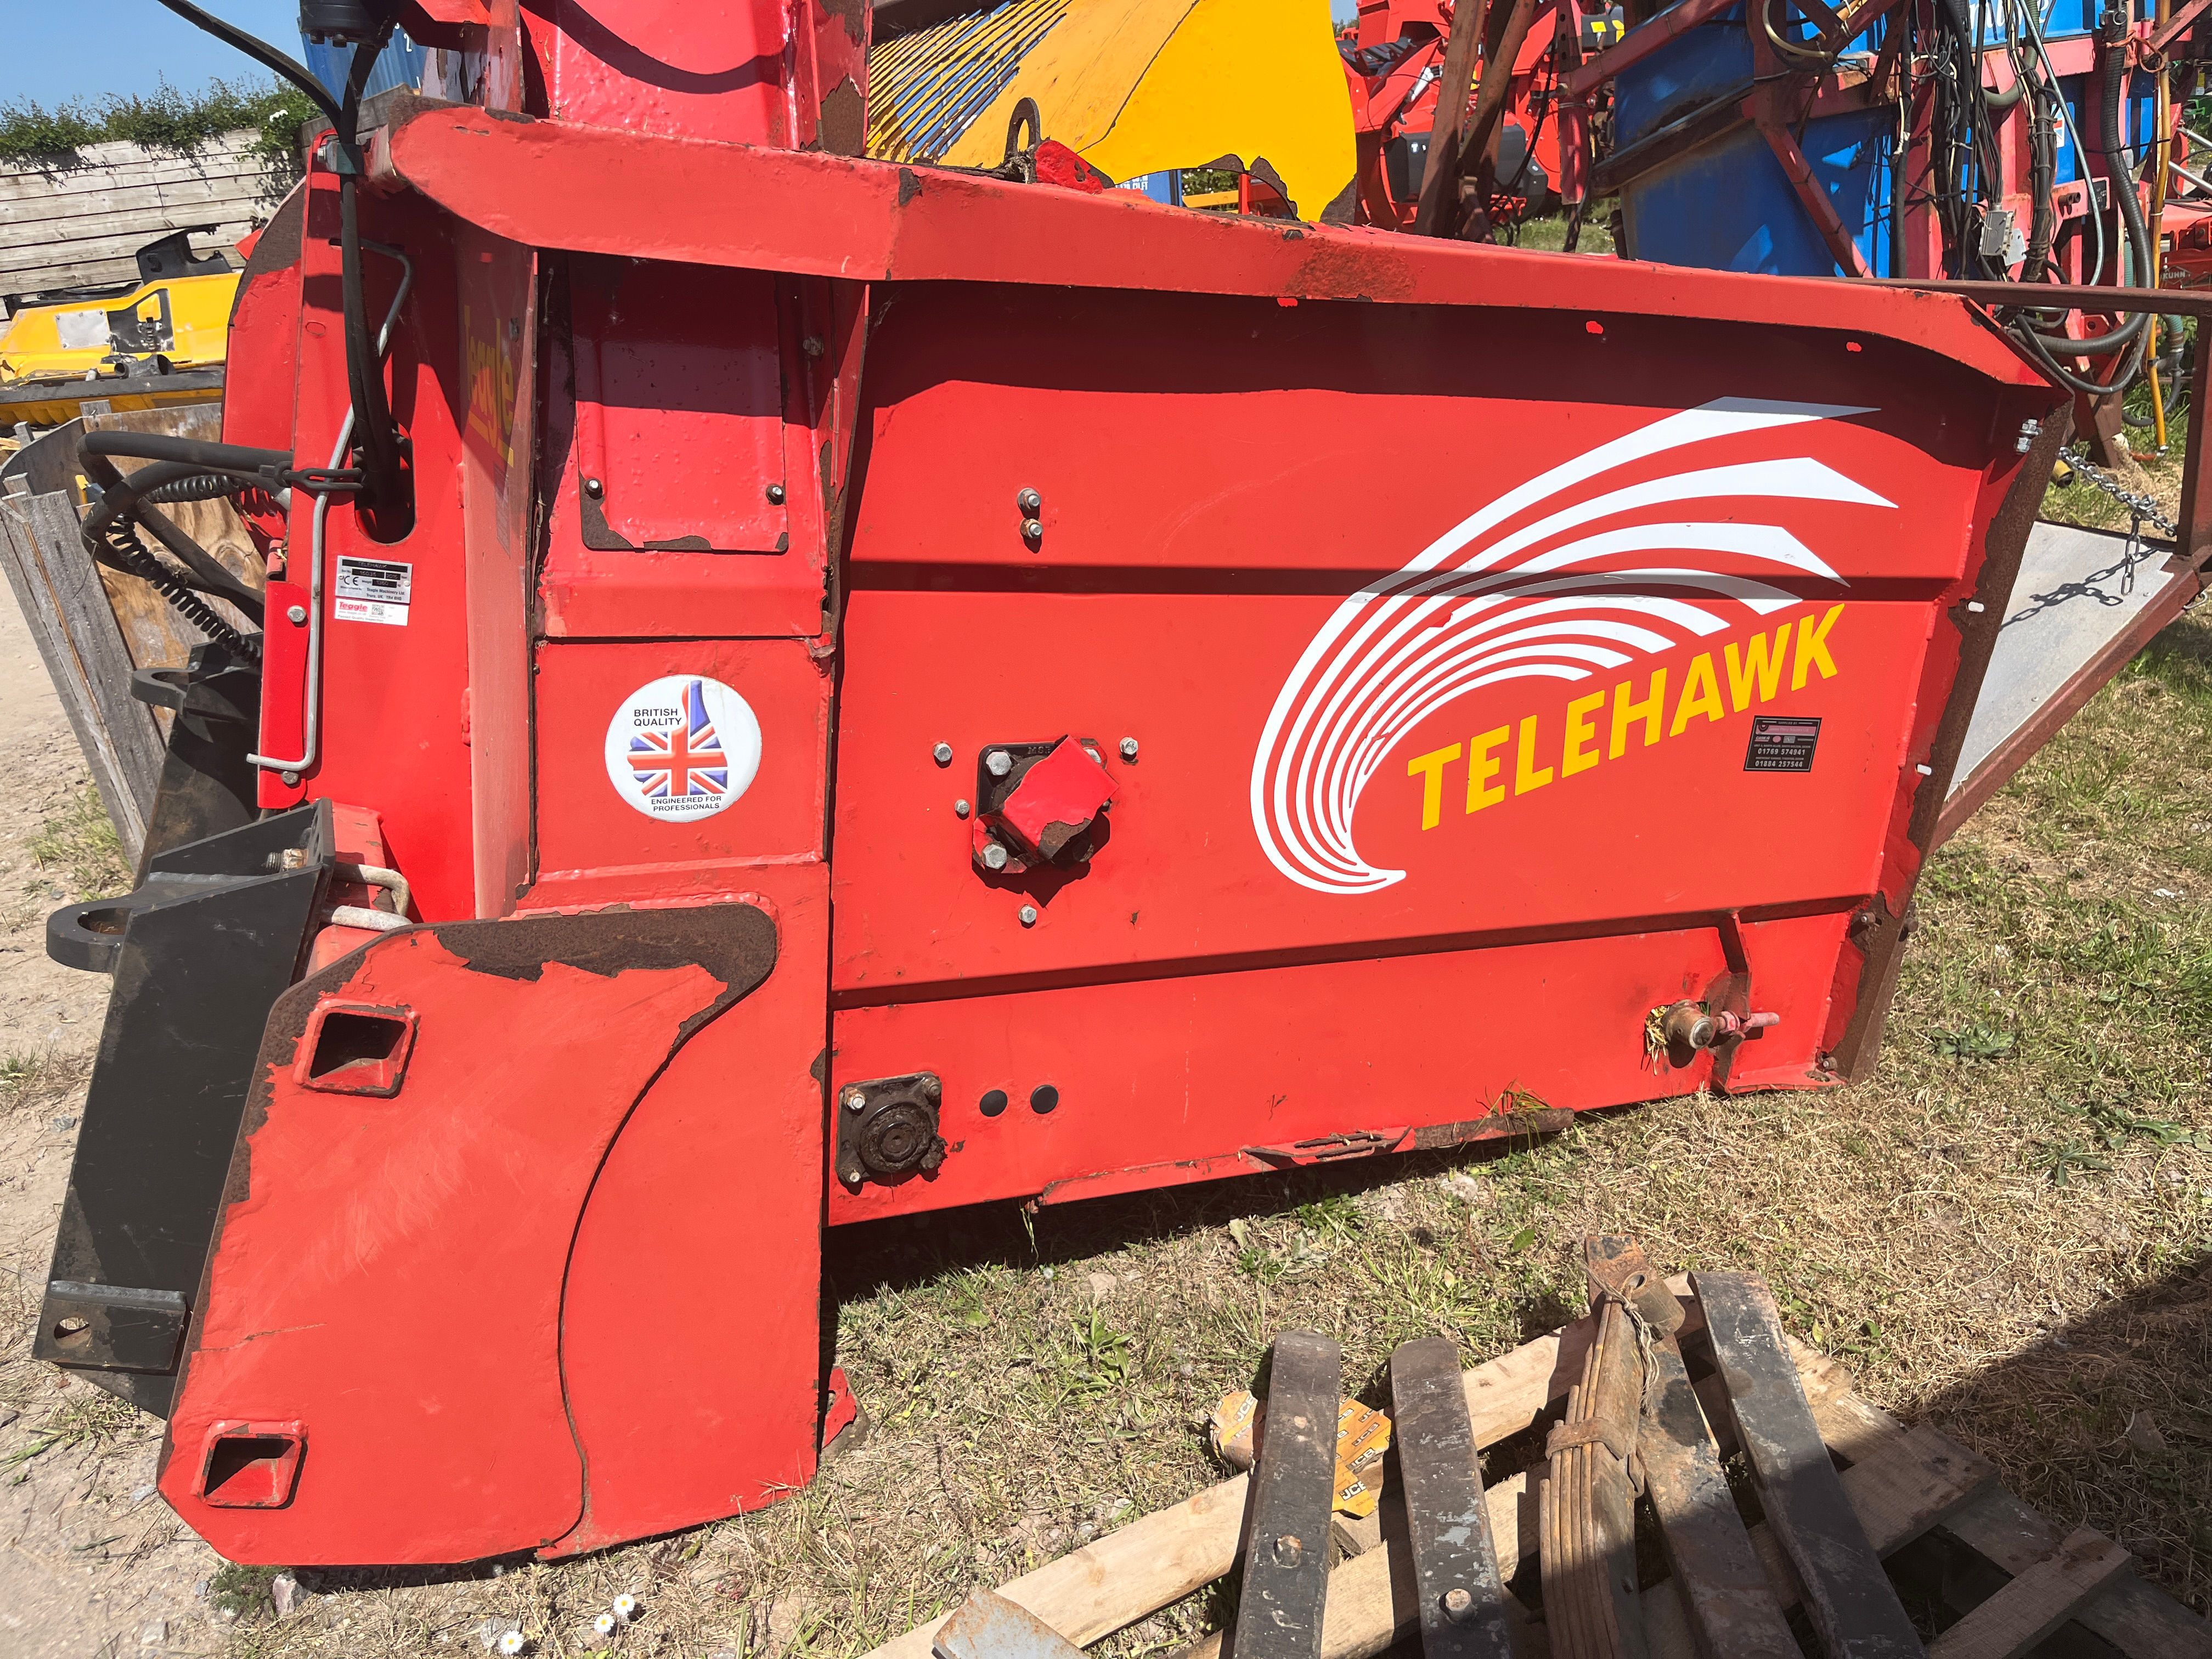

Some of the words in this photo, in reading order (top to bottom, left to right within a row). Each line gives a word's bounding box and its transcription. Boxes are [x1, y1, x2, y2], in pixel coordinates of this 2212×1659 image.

[2163, 271, 2186, 280] KUHN
[358, 561, 387, 569] TELEHAWK
[343, 575, 359, 586] CE
[338, 601, 368, 612] Teagle
[634, 708, 678, 717] BRITISH
[1407, 603, 1845, 831] TELEHAWK
[634, 718, 682, 726] QUALITY
[651, 797, 703, 805] ENGINEERED
[653, 803, 720, 812] PROFESSIONALS
[1354, 1423, 1379, 1446] JCB
